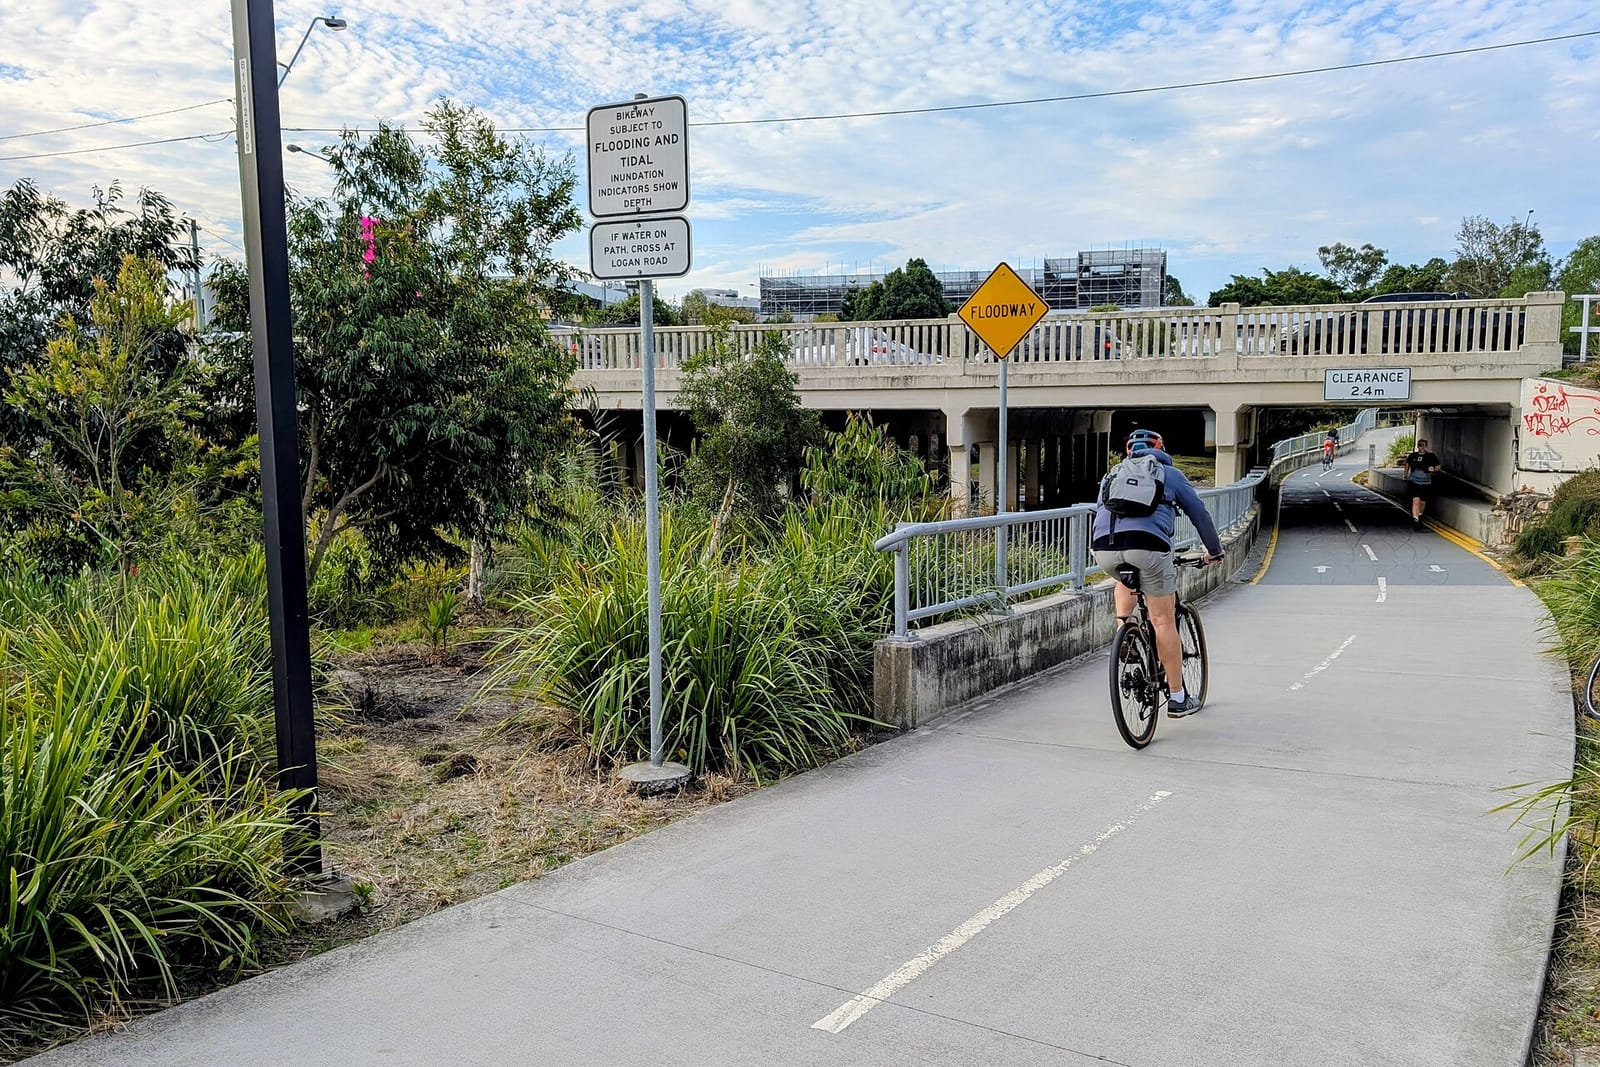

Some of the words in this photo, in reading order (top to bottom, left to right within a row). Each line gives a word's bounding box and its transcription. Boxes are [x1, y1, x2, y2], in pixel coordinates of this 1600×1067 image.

[616, 108, 655, 121] BIKEWAY
[609, 122, 649, 135] SUBJECT
[651, 120, 663, 130] TO
[595, 137, 650, 153] FLOODING
[654, 133, 679, 147] AND
[620, 154, 654, 168] TIDAL
[610, 169, 664, 182] INUNDATION
[598, 184, 650, 197] INDICATORS
[653, 181, 678, 192] SHOW
[623, 198, 652, 208] DEPTH
[611, 232, 620, 241] IF
[622, 231, 652, 241] WATER
[654, 229, 667, 239] ON
[631, 243, 661, 253] CROSS
[663, 242, 676, 251] AT
[611, 258, 640, 268] LOGAN
[643, 256, 668, 265] ROAD
[970, 302, 1036, 320] FLOODWAY
[1332, 372, 1404, 383] CLEARANCE
